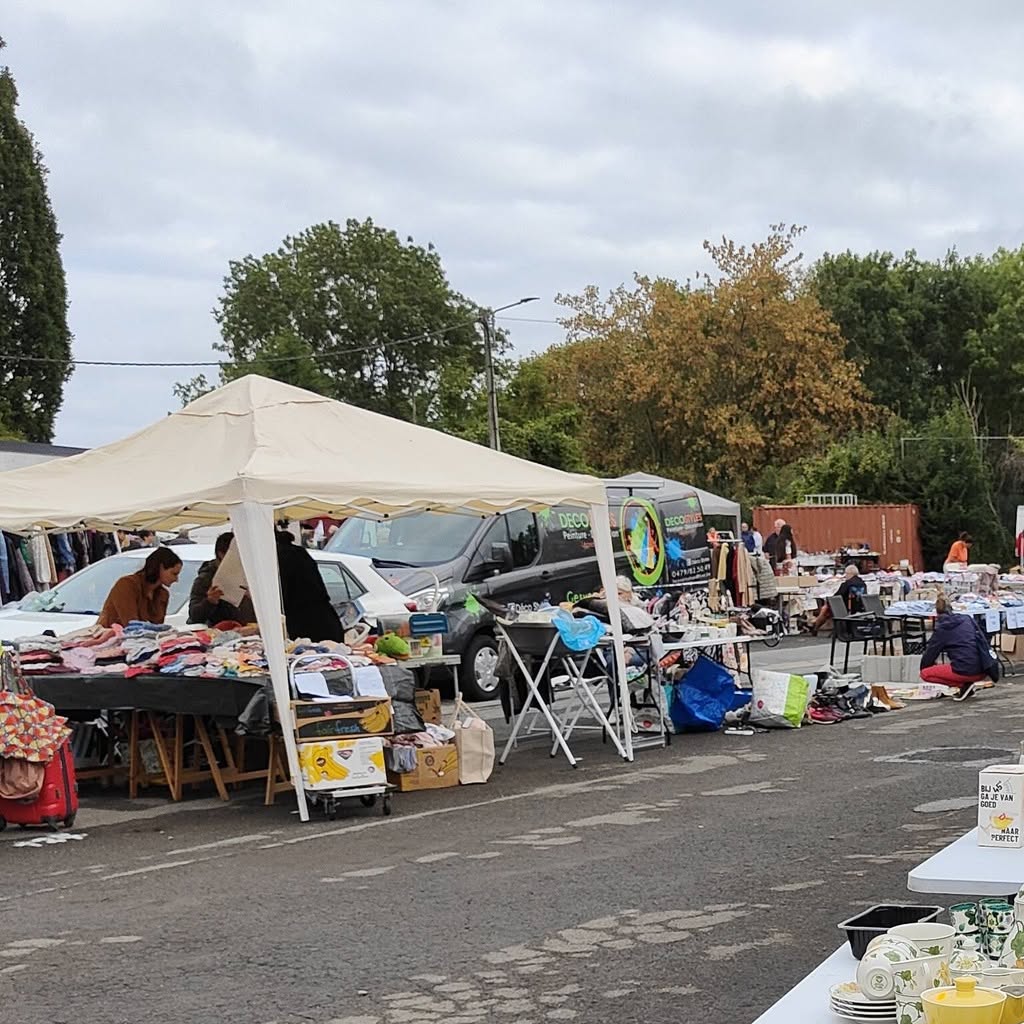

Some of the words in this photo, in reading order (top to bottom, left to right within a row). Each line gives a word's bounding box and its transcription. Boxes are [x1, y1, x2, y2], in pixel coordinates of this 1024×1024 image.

[559, 511, 617, 528] DECOS
[562, 530, 588, 540] Peinture
[980, 785, 992, 793] BIJ
[990, 793, 999, 801] JE
[980, 800, 997, 808] GOED
[1001, 827, 1019, 835] NAAR
[991, 834, 1019, 842] PERFECT
